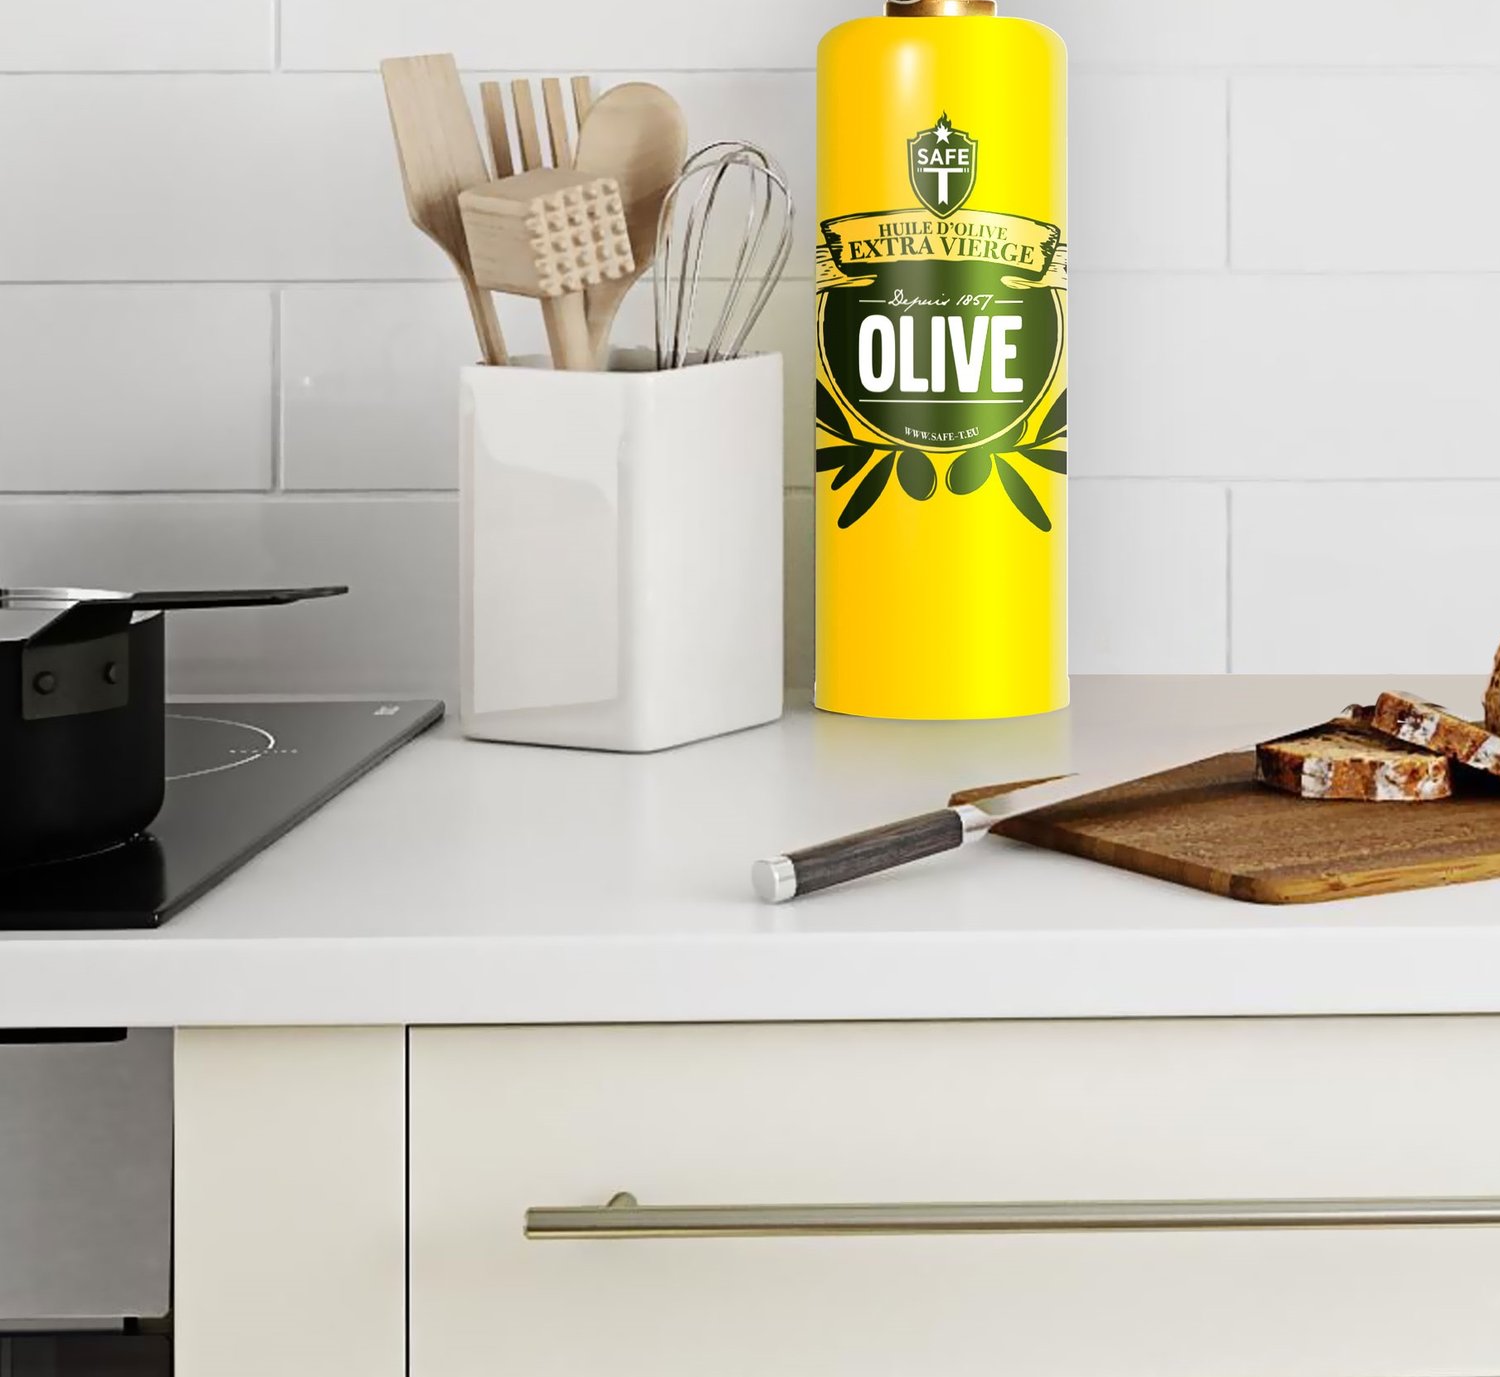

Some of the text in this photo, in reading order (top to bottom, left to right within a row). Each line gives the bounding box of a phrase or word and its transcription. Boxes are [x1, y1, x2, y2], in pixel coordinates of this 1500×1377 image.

[917, 148, 970, 165] SAFE
[920, 167, 968, 205] T
[879, 221, 1008, 241] HUILE D’OLIVE
[848, 236, 1035, 265] EXTRA VIERGE
[888, 288, 994, 312] Depuis 1857
[858, 314, 1024, 393] OLIVE
[904, 426, 980, 442] WWW.SAFE-T.EU
